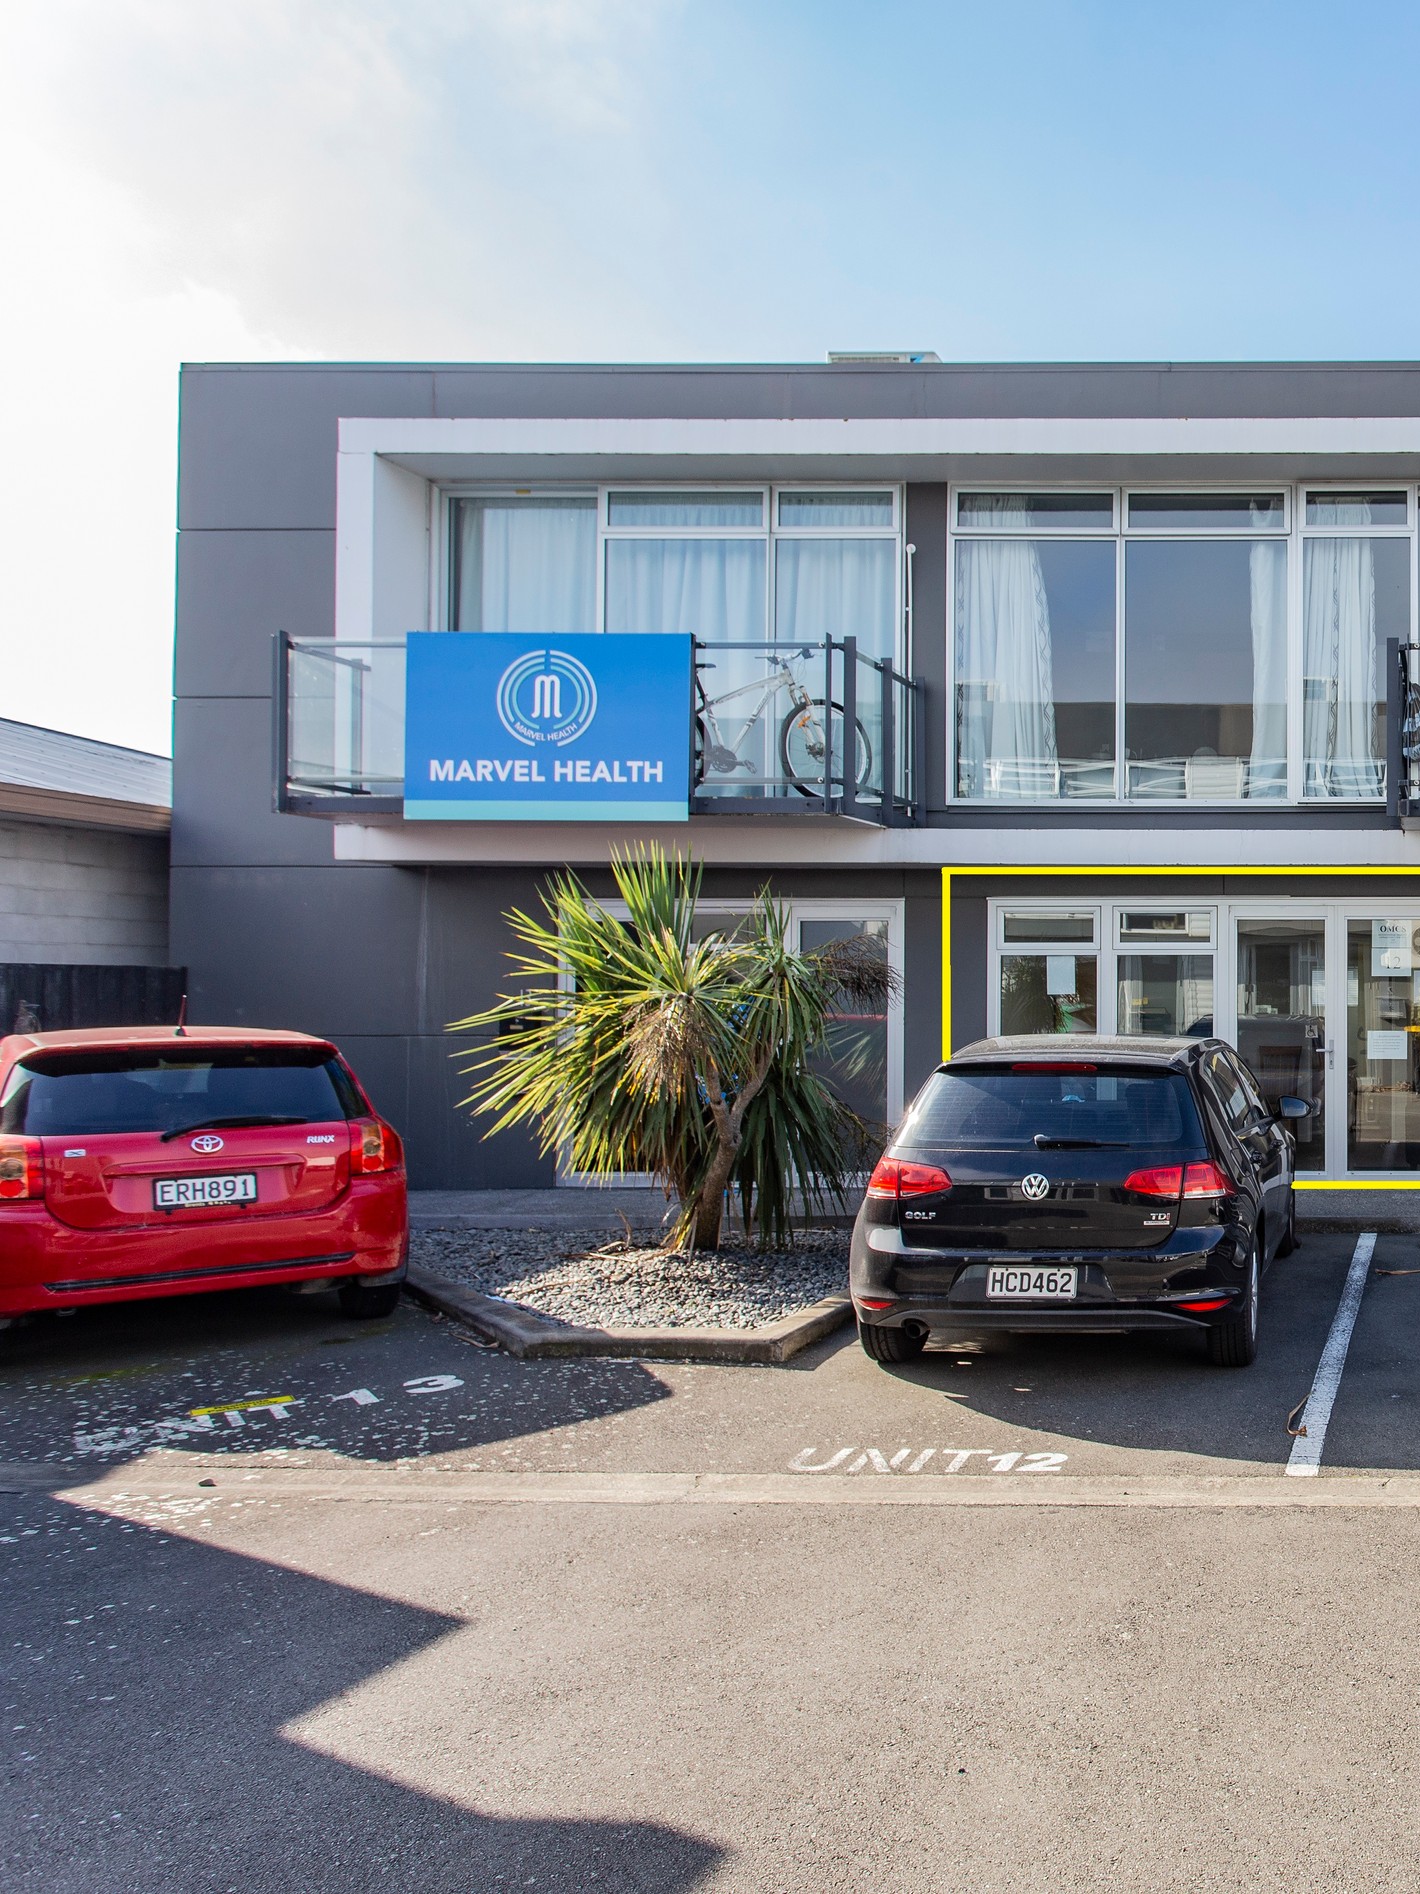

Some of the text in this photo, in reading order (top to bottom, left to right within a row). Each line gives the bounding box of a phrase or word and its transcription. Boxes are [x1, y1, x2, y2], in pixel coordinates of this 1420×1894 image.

[514, 721, 578, 741] MARVEL HEALTH
[430, 759, 664, 783] MARVEL HEALTH
[306, 1134, 335, 1144] RUNX
[159, 1178, 250, 1203] ERH891
[904, 1211, 937, 1220] GOLF
[990, 1271, 1073, 1294] HCD462
